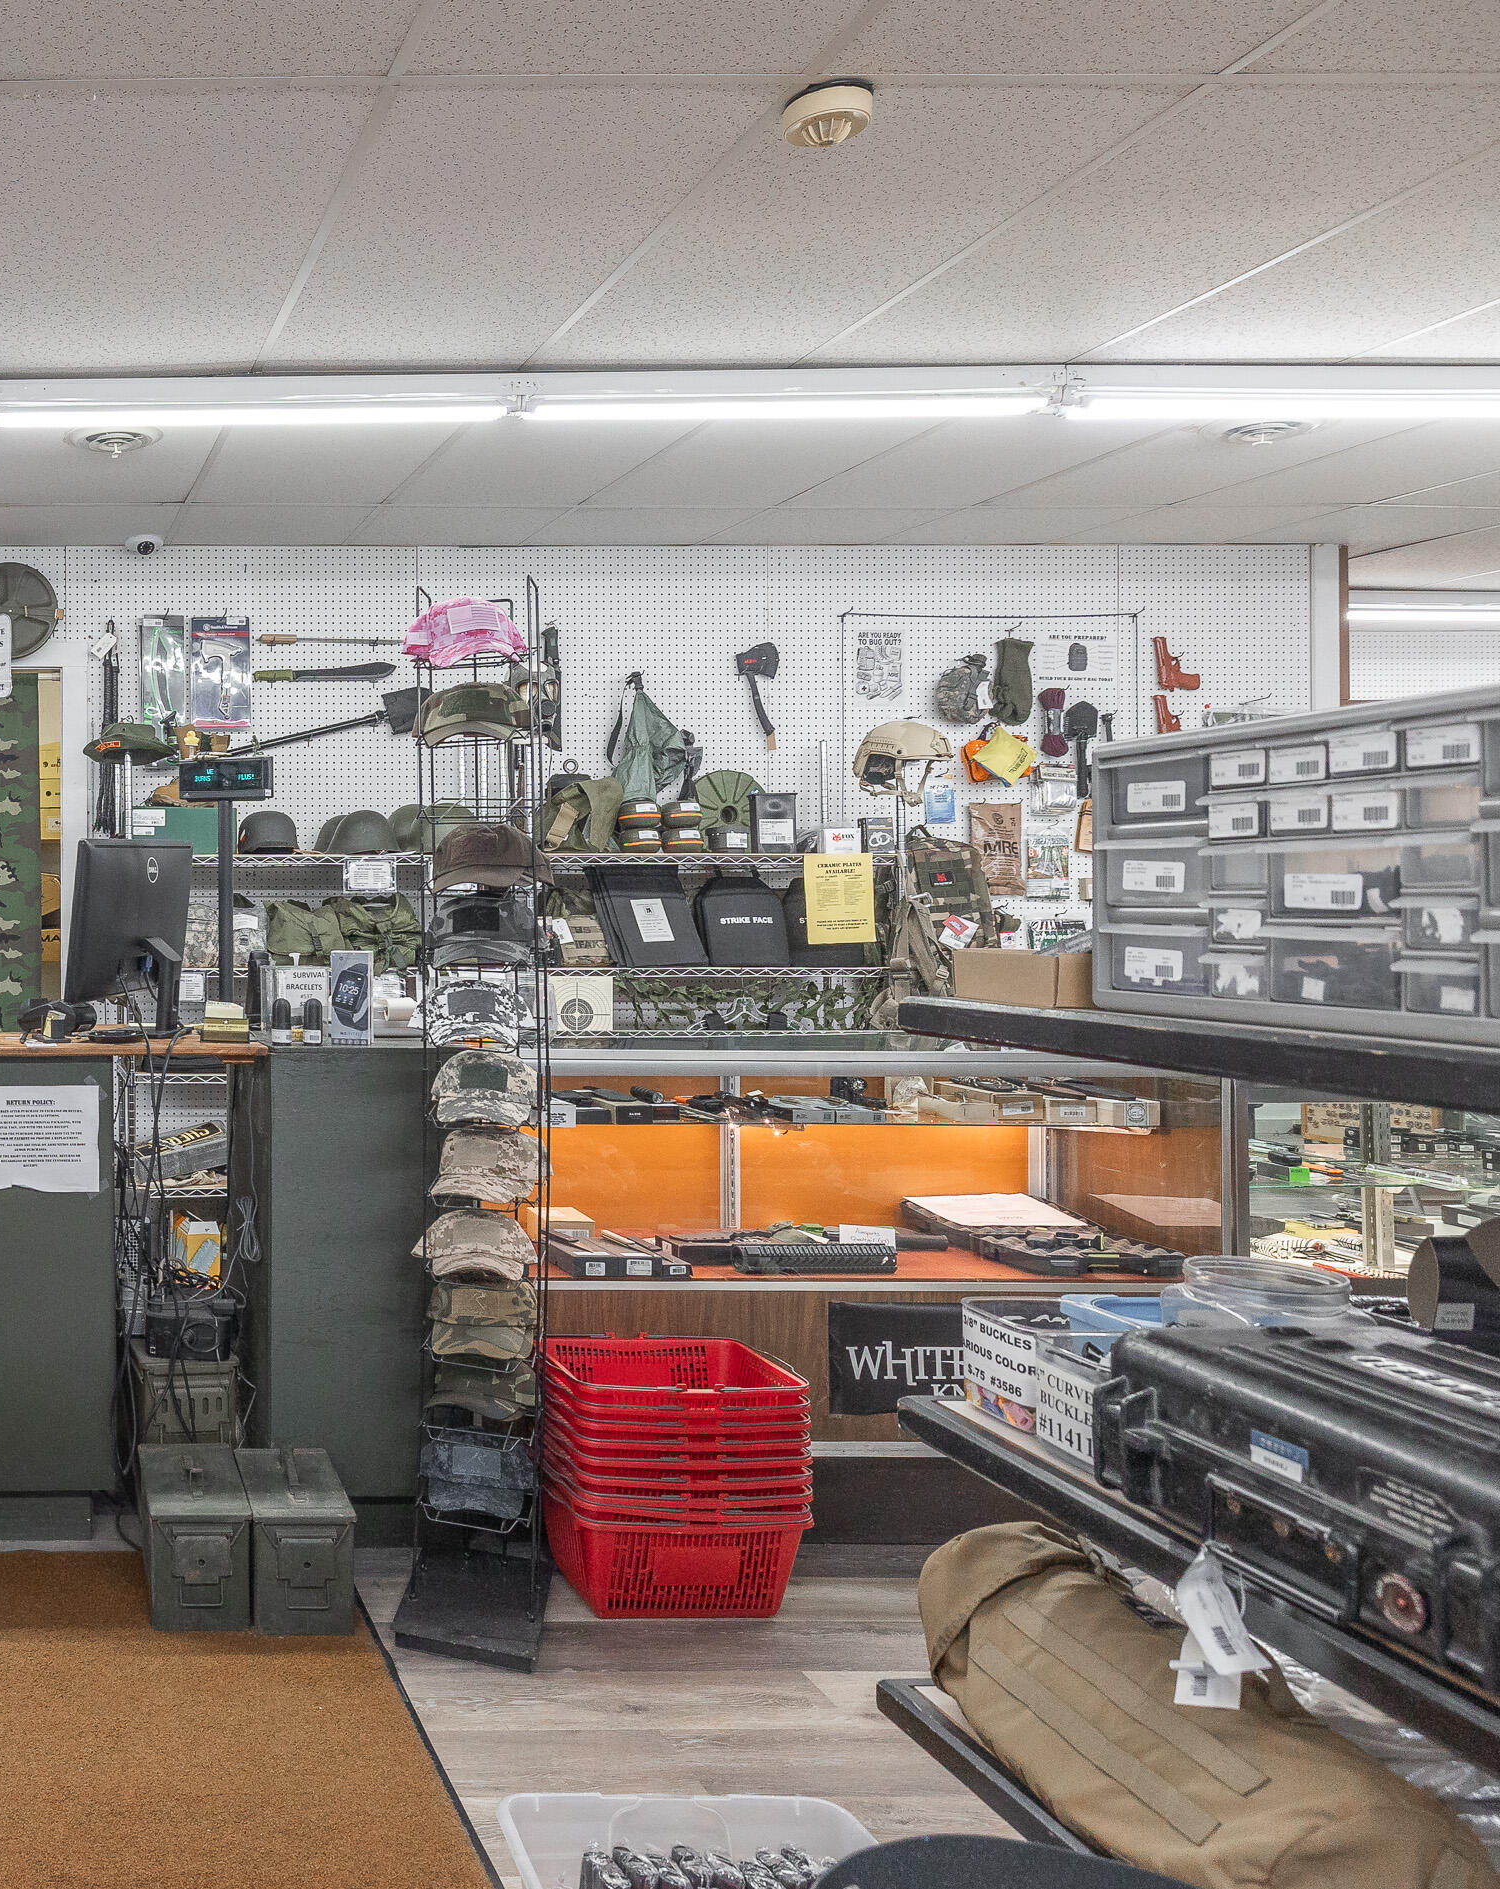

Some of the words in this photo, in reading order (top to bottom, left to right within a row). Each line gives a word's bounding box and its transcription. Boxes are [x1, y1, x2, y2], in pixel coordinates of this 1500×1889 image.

[983, 841, 1018, 855] MRE
[720, 917, 750, 925] STRIKE
[286, 983, 323, 991] BRACELETS
[339, 983, 359, 995] 10:25
[980, 1323, 1032, 1351] BUCKLES
[968, 1363, 985, 1381] $.75
[990, 1375, 1022, 1397] #3586
